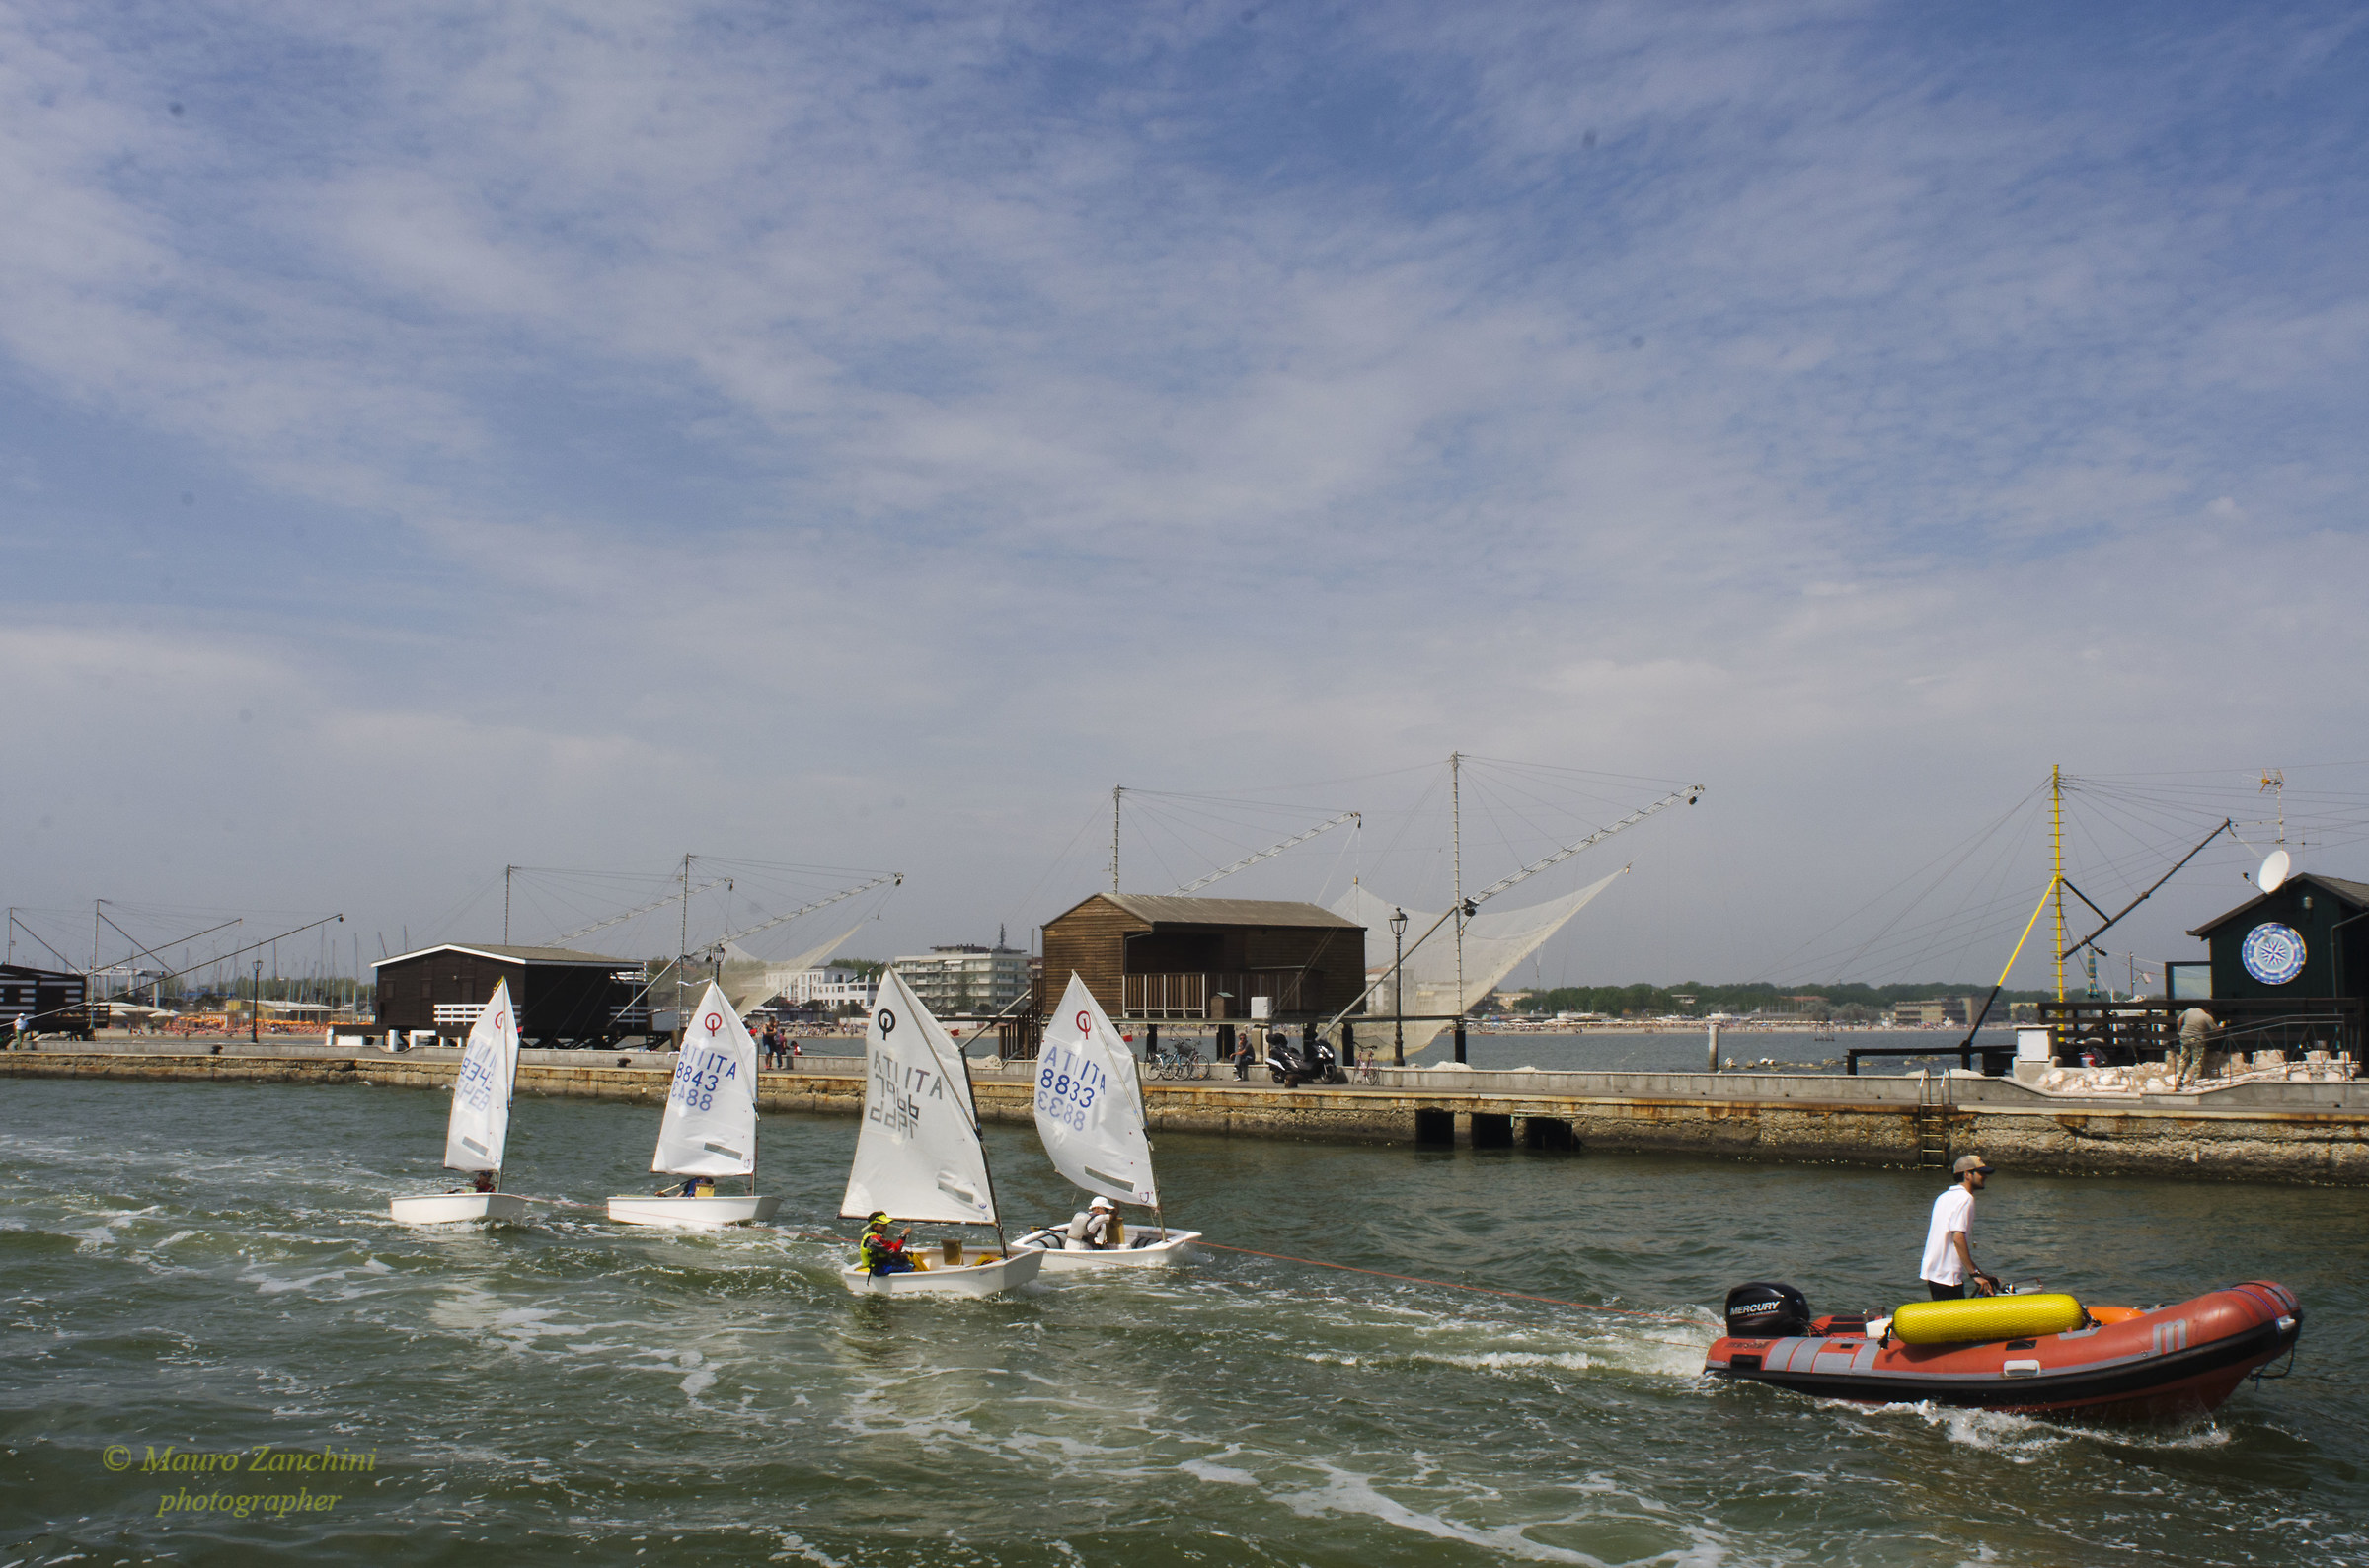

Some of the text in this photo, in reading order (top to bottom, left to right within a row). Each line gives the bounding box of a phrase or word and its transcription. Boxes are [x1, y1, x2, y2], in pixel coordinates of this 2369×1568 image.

[675, 1061, 719, 1092] 8843
[1040, 1068, 1091, 1109] 8833
[1729, 1301, 1781, 1316] MERCURY
